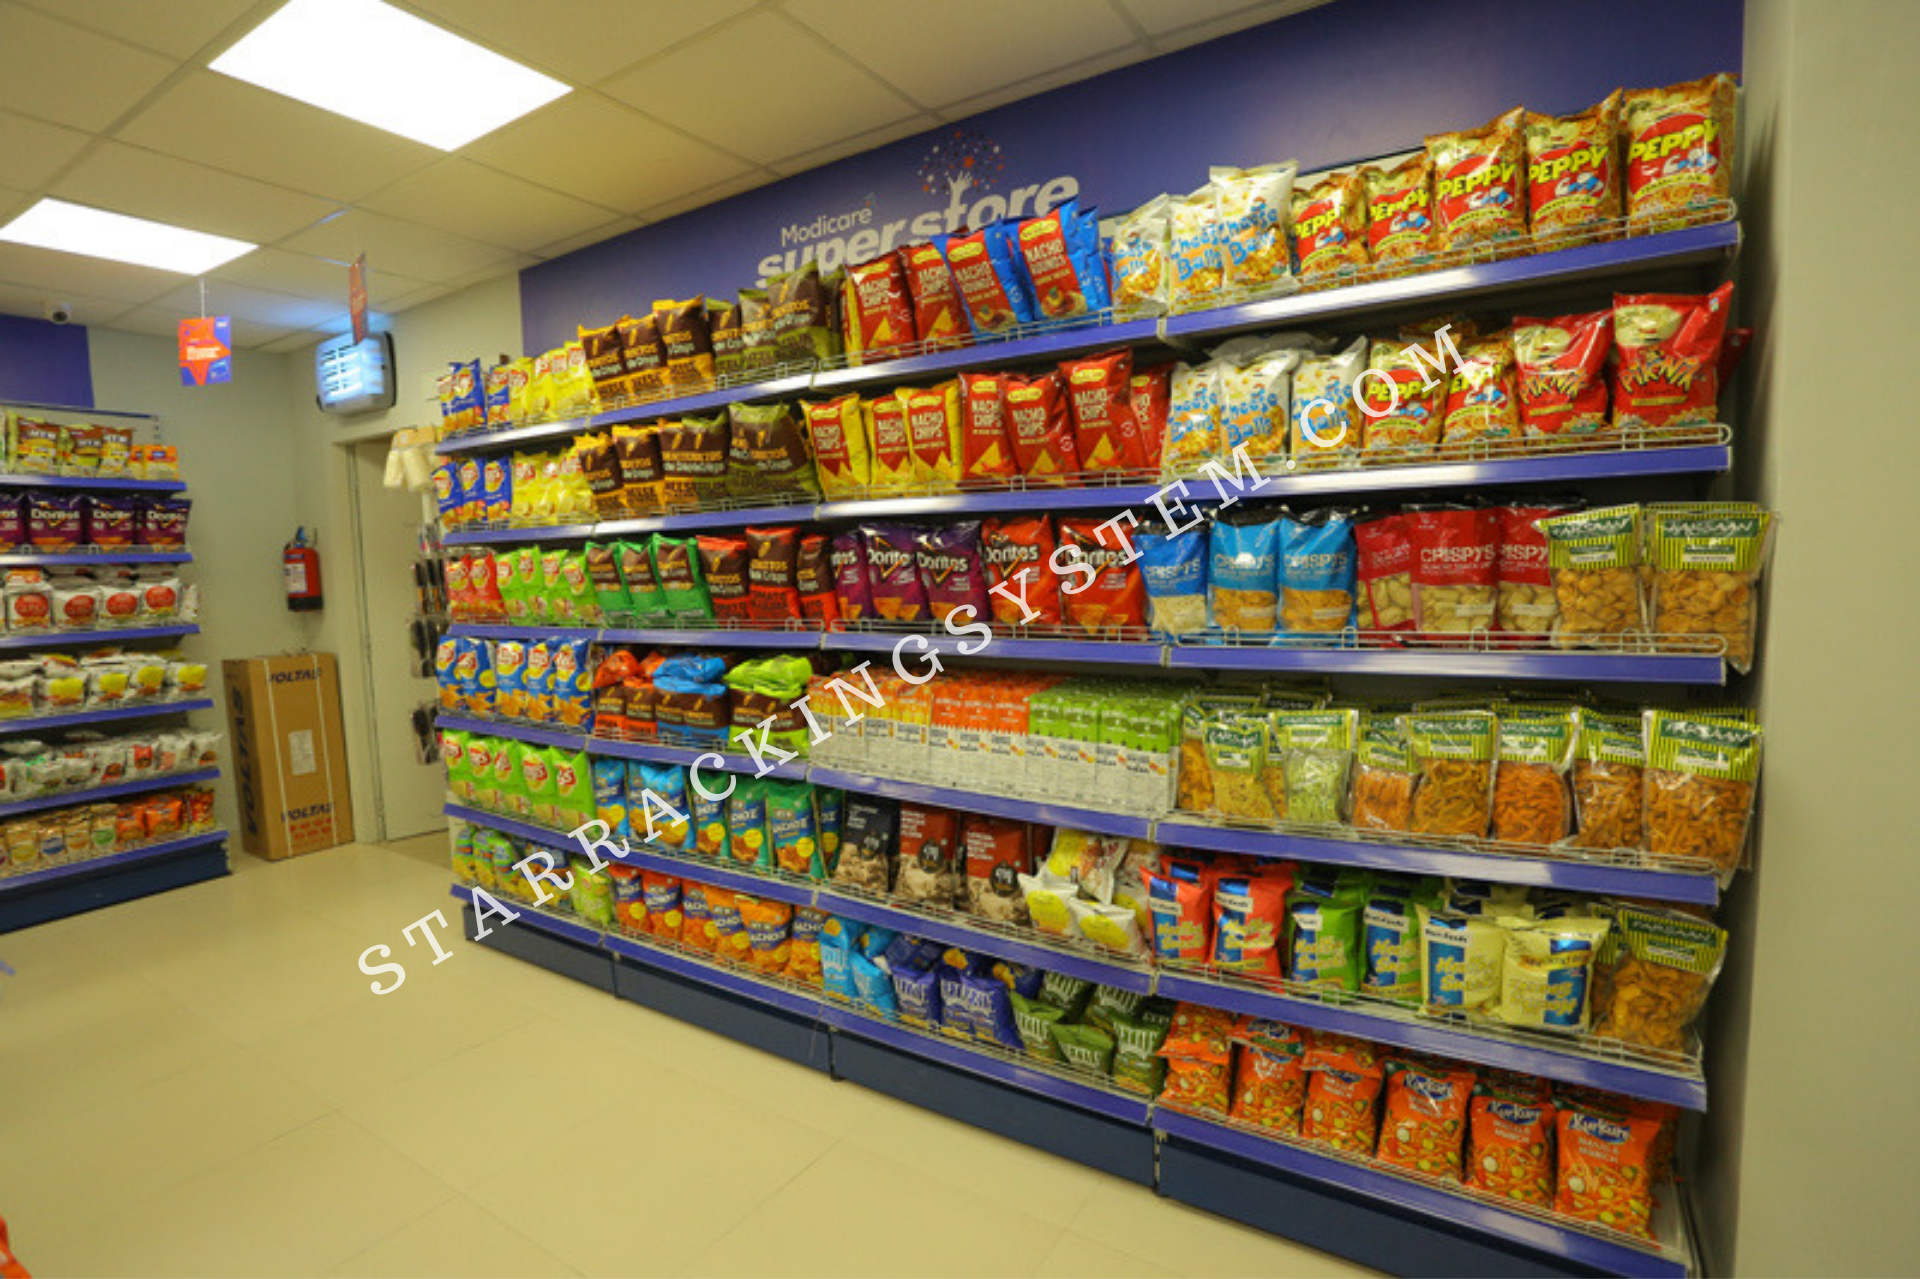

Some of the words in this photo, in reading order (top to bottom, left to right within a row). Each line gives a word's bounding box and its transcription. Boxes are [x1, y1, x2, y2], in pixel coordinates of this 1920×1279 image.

[1627, 118, 1721, 163] PEPPY
[1529, 145, 1609, 183] PEPPY
[1437, 161, 1517, 200] PEPPY
[755, 175, 1079, 288] superstore
[781, 206, 873, 248] Modicare
[1025, 239, 1064, 262] NACHO
[956, 261, 993, 283] NACHO
[1074, 389, 1107, 406] NACHO
[911, 410, 944, 428] NACHO
[1012, 406, 1047, 423] NACHO
[1079, 404, 1108, 421] CHIPS
[914, 426, 944, 441] CHIPS
[1016, 421, 1046, 437] CHIPS
[918, 552, 968, 572] Doritos
[985, 545, 1039, 562] Doritos
